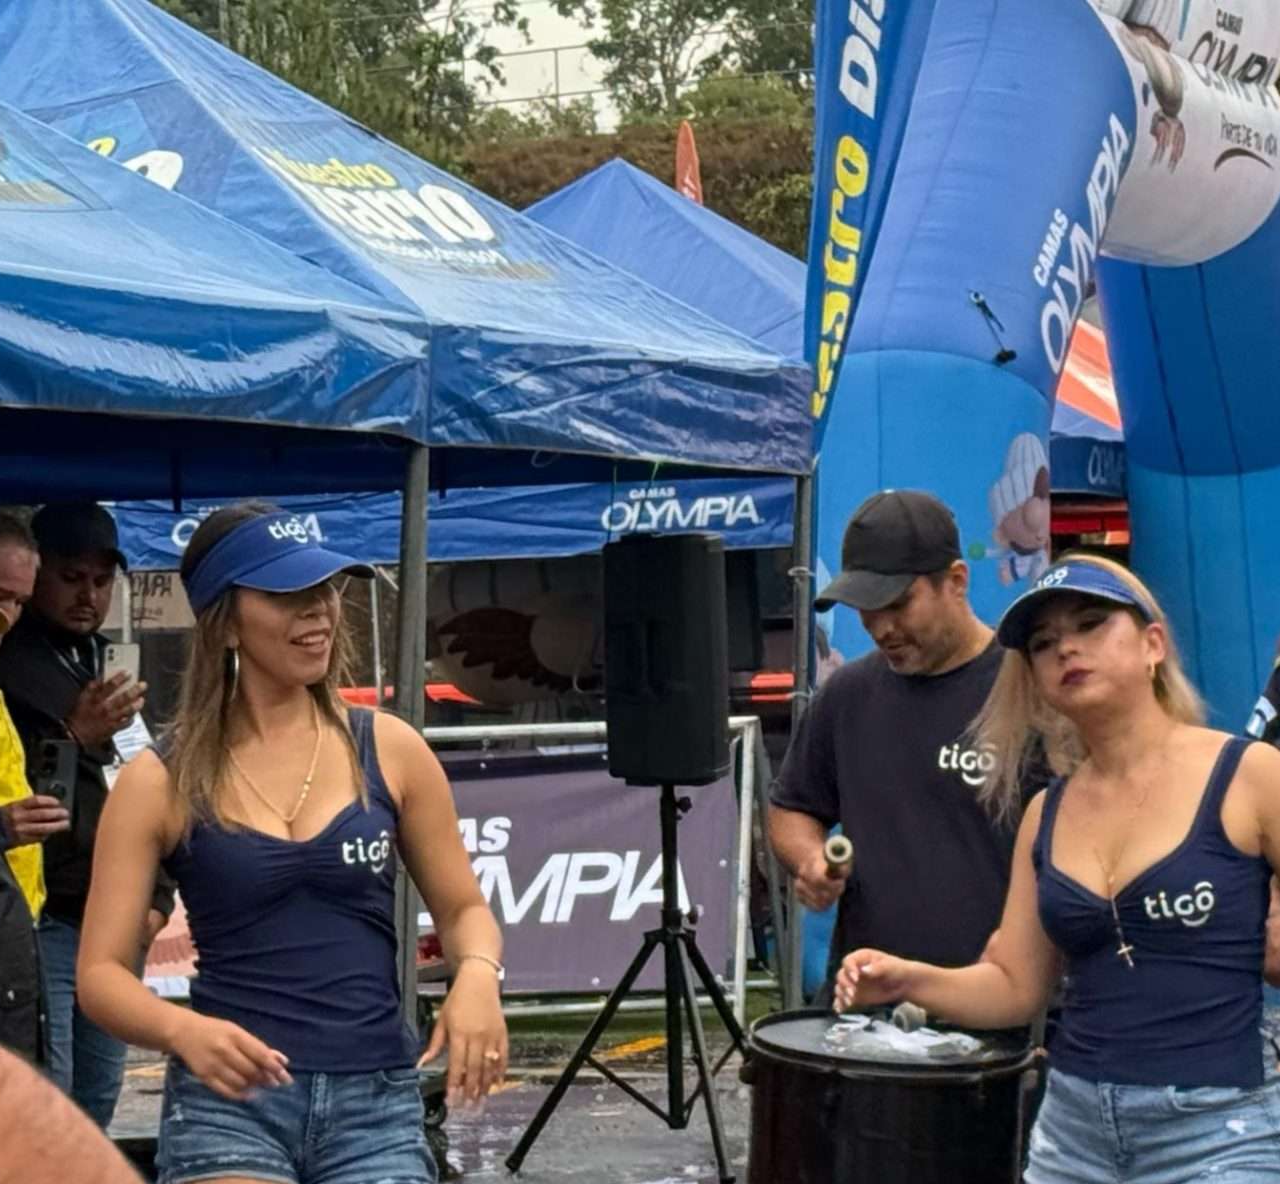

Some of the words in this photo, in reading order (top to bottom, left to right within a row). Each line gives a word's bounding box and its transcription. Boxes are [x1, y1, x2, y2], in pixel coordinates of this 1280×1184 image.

[1033, 207, 1069, 288] CAMAS
[1039, 111, 1131, 376] OLYMPIA
[600, 494, 767, 532] OLYMPIA
[629, 486, 677, 500] CAMAS
